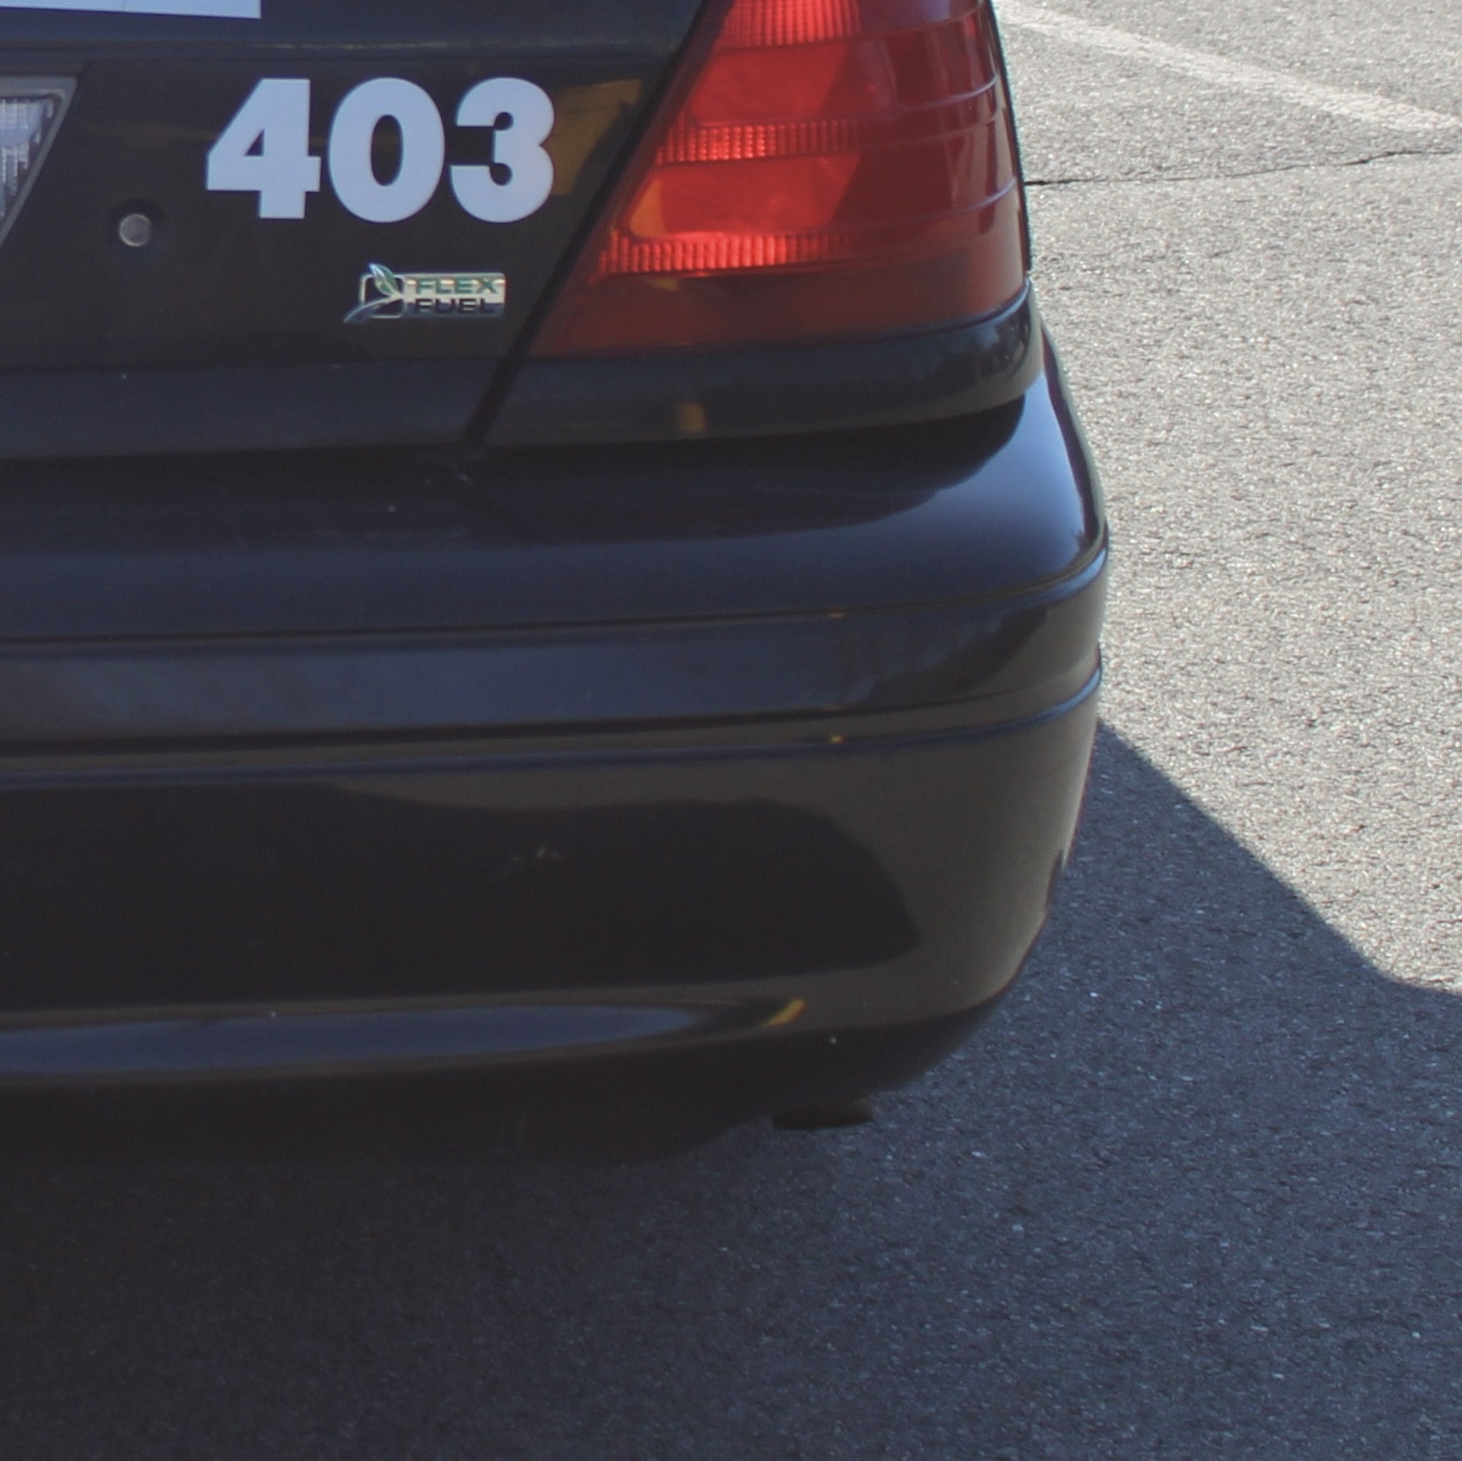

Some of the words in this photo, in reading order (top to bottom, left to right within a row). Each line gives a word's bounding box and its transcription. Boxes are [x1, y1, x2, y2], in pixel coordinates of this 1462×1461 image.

[206, 77, 555, 223] 403
[415, 278, 499, 295] FLEX
[414, 297, 496, 313] FUEL
